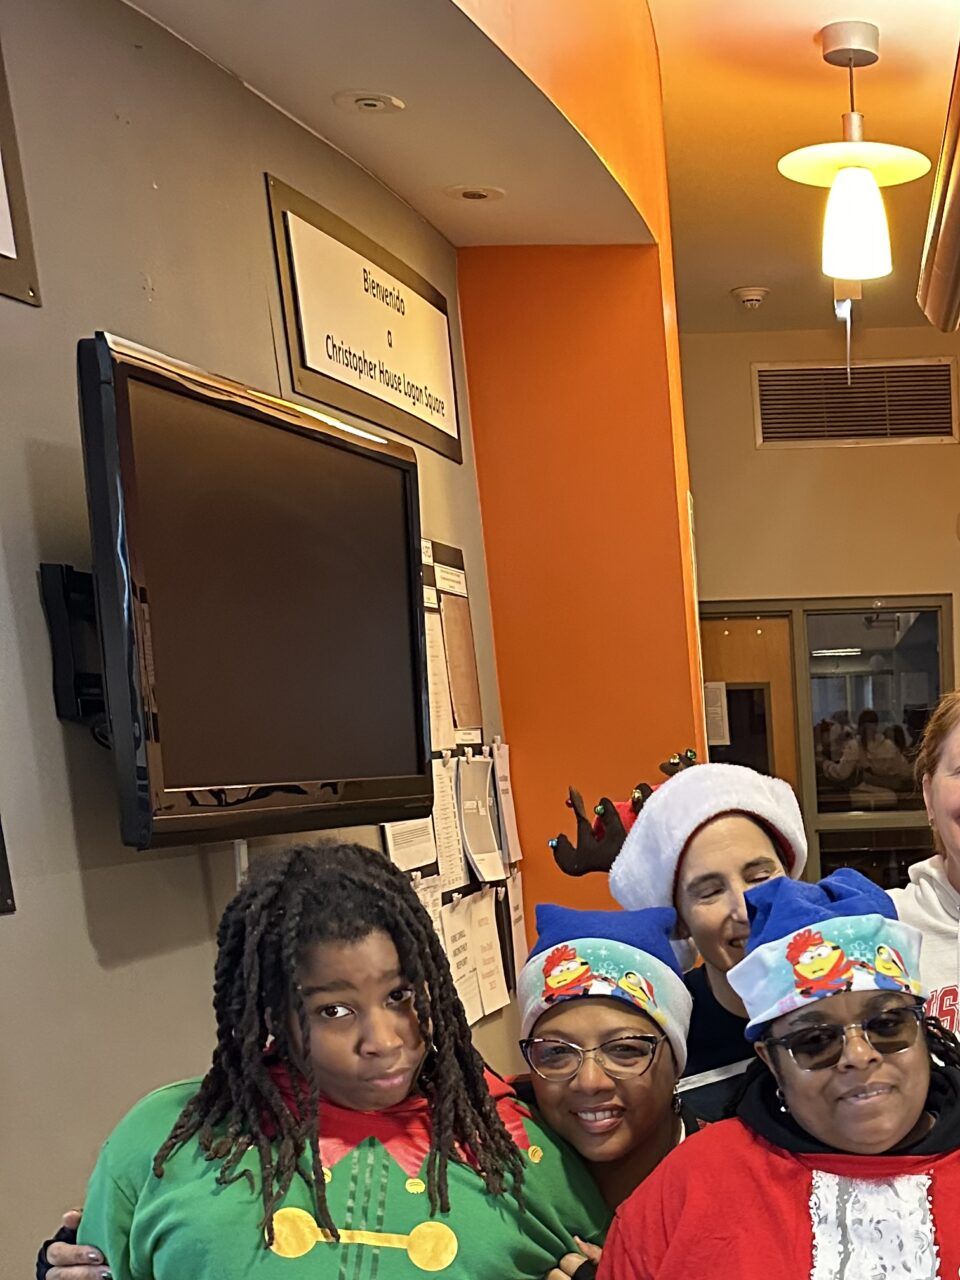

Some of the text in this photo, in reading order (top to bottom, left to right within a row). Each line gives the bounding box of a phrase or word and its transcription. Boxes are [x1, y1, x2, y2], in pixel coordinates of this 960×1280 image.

[362, 268, 406, 316] Bienvenido
[387, 329, 393, 349] a
[325, 334, 446, 417] Christopher House Logan Square
